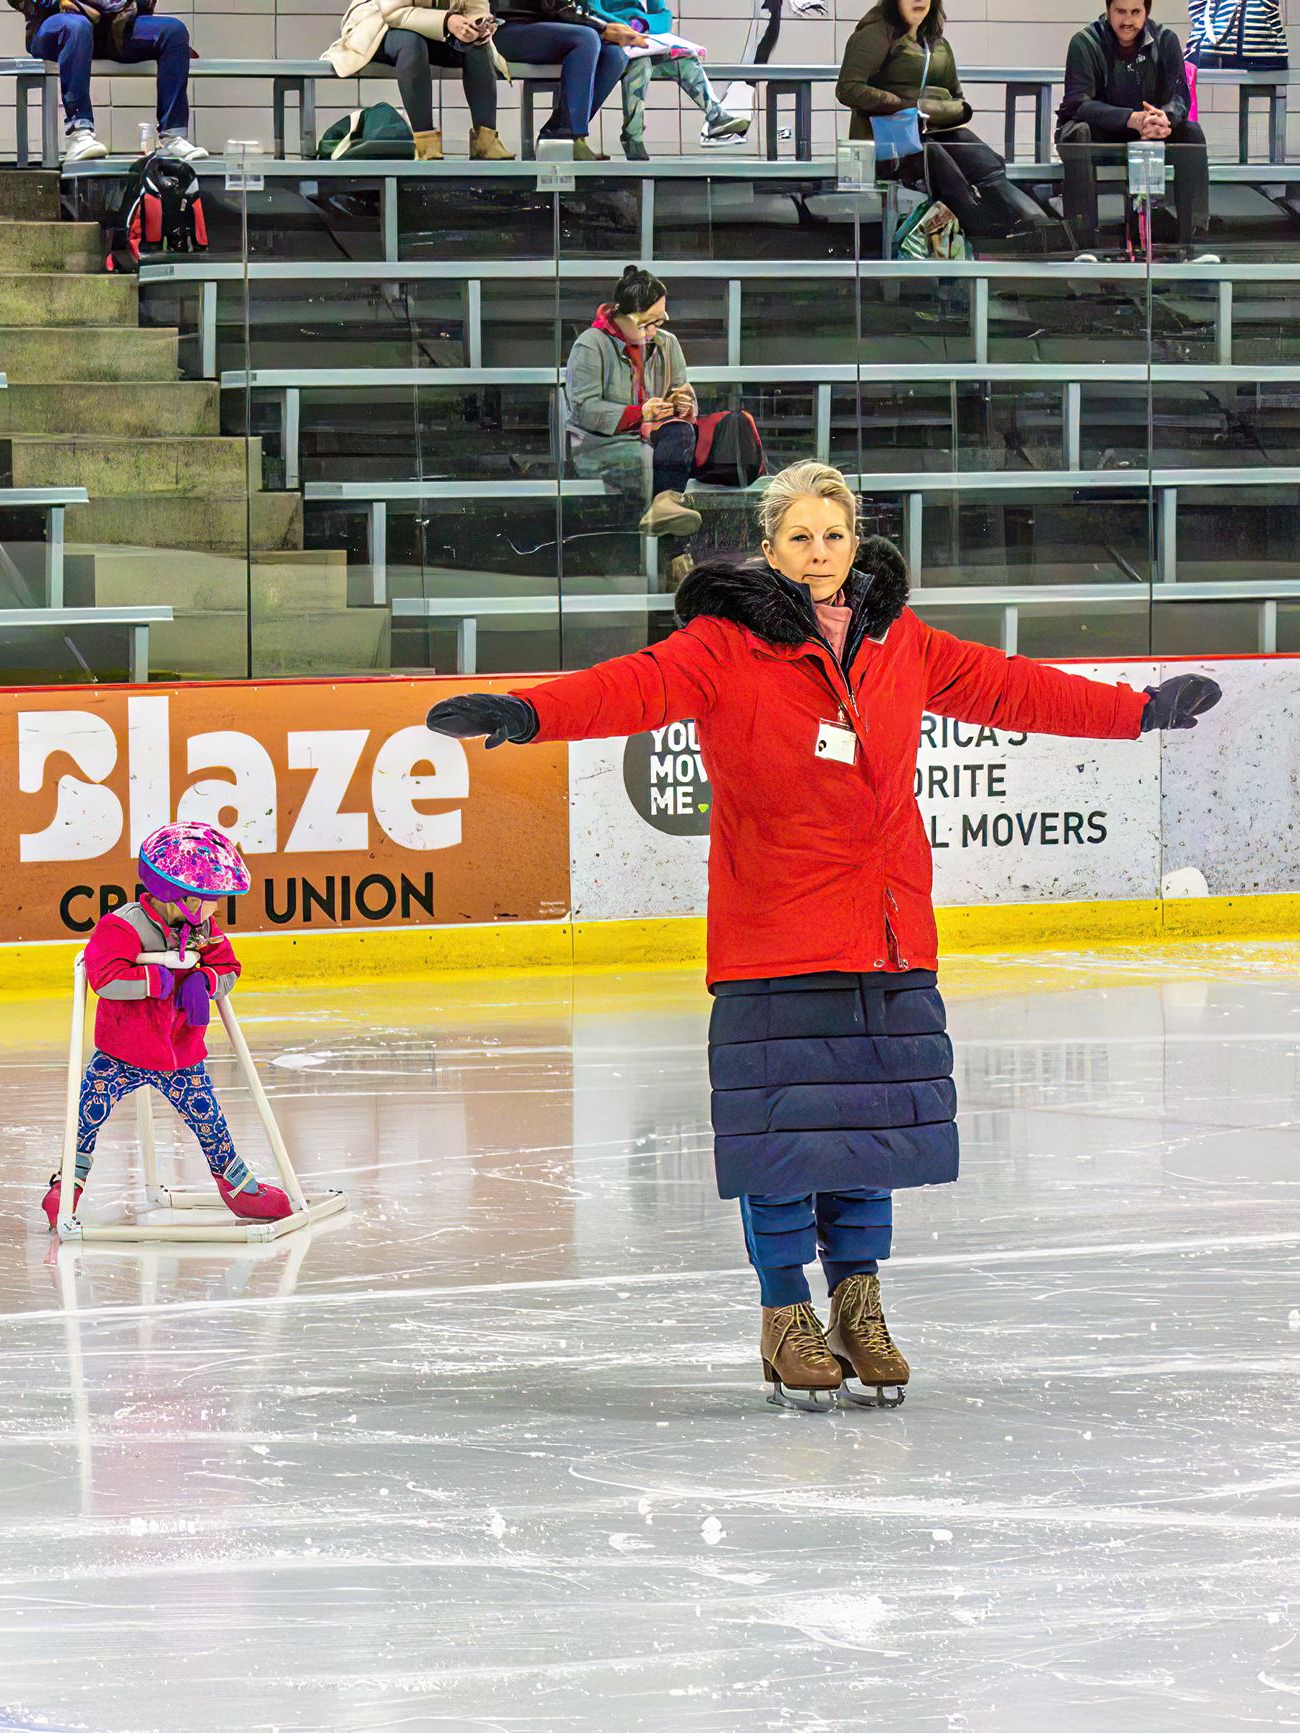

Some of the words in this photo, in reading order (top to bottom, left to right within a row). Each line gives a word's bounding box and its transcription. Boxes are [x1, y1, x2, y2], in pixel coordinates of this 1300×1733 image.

[17, 695, 469, 862] Blaze
[650, 785, 694, 815] ME
[962, 811, 1108, 848] MOVERS
[265, 872, 434, 924] UNION
